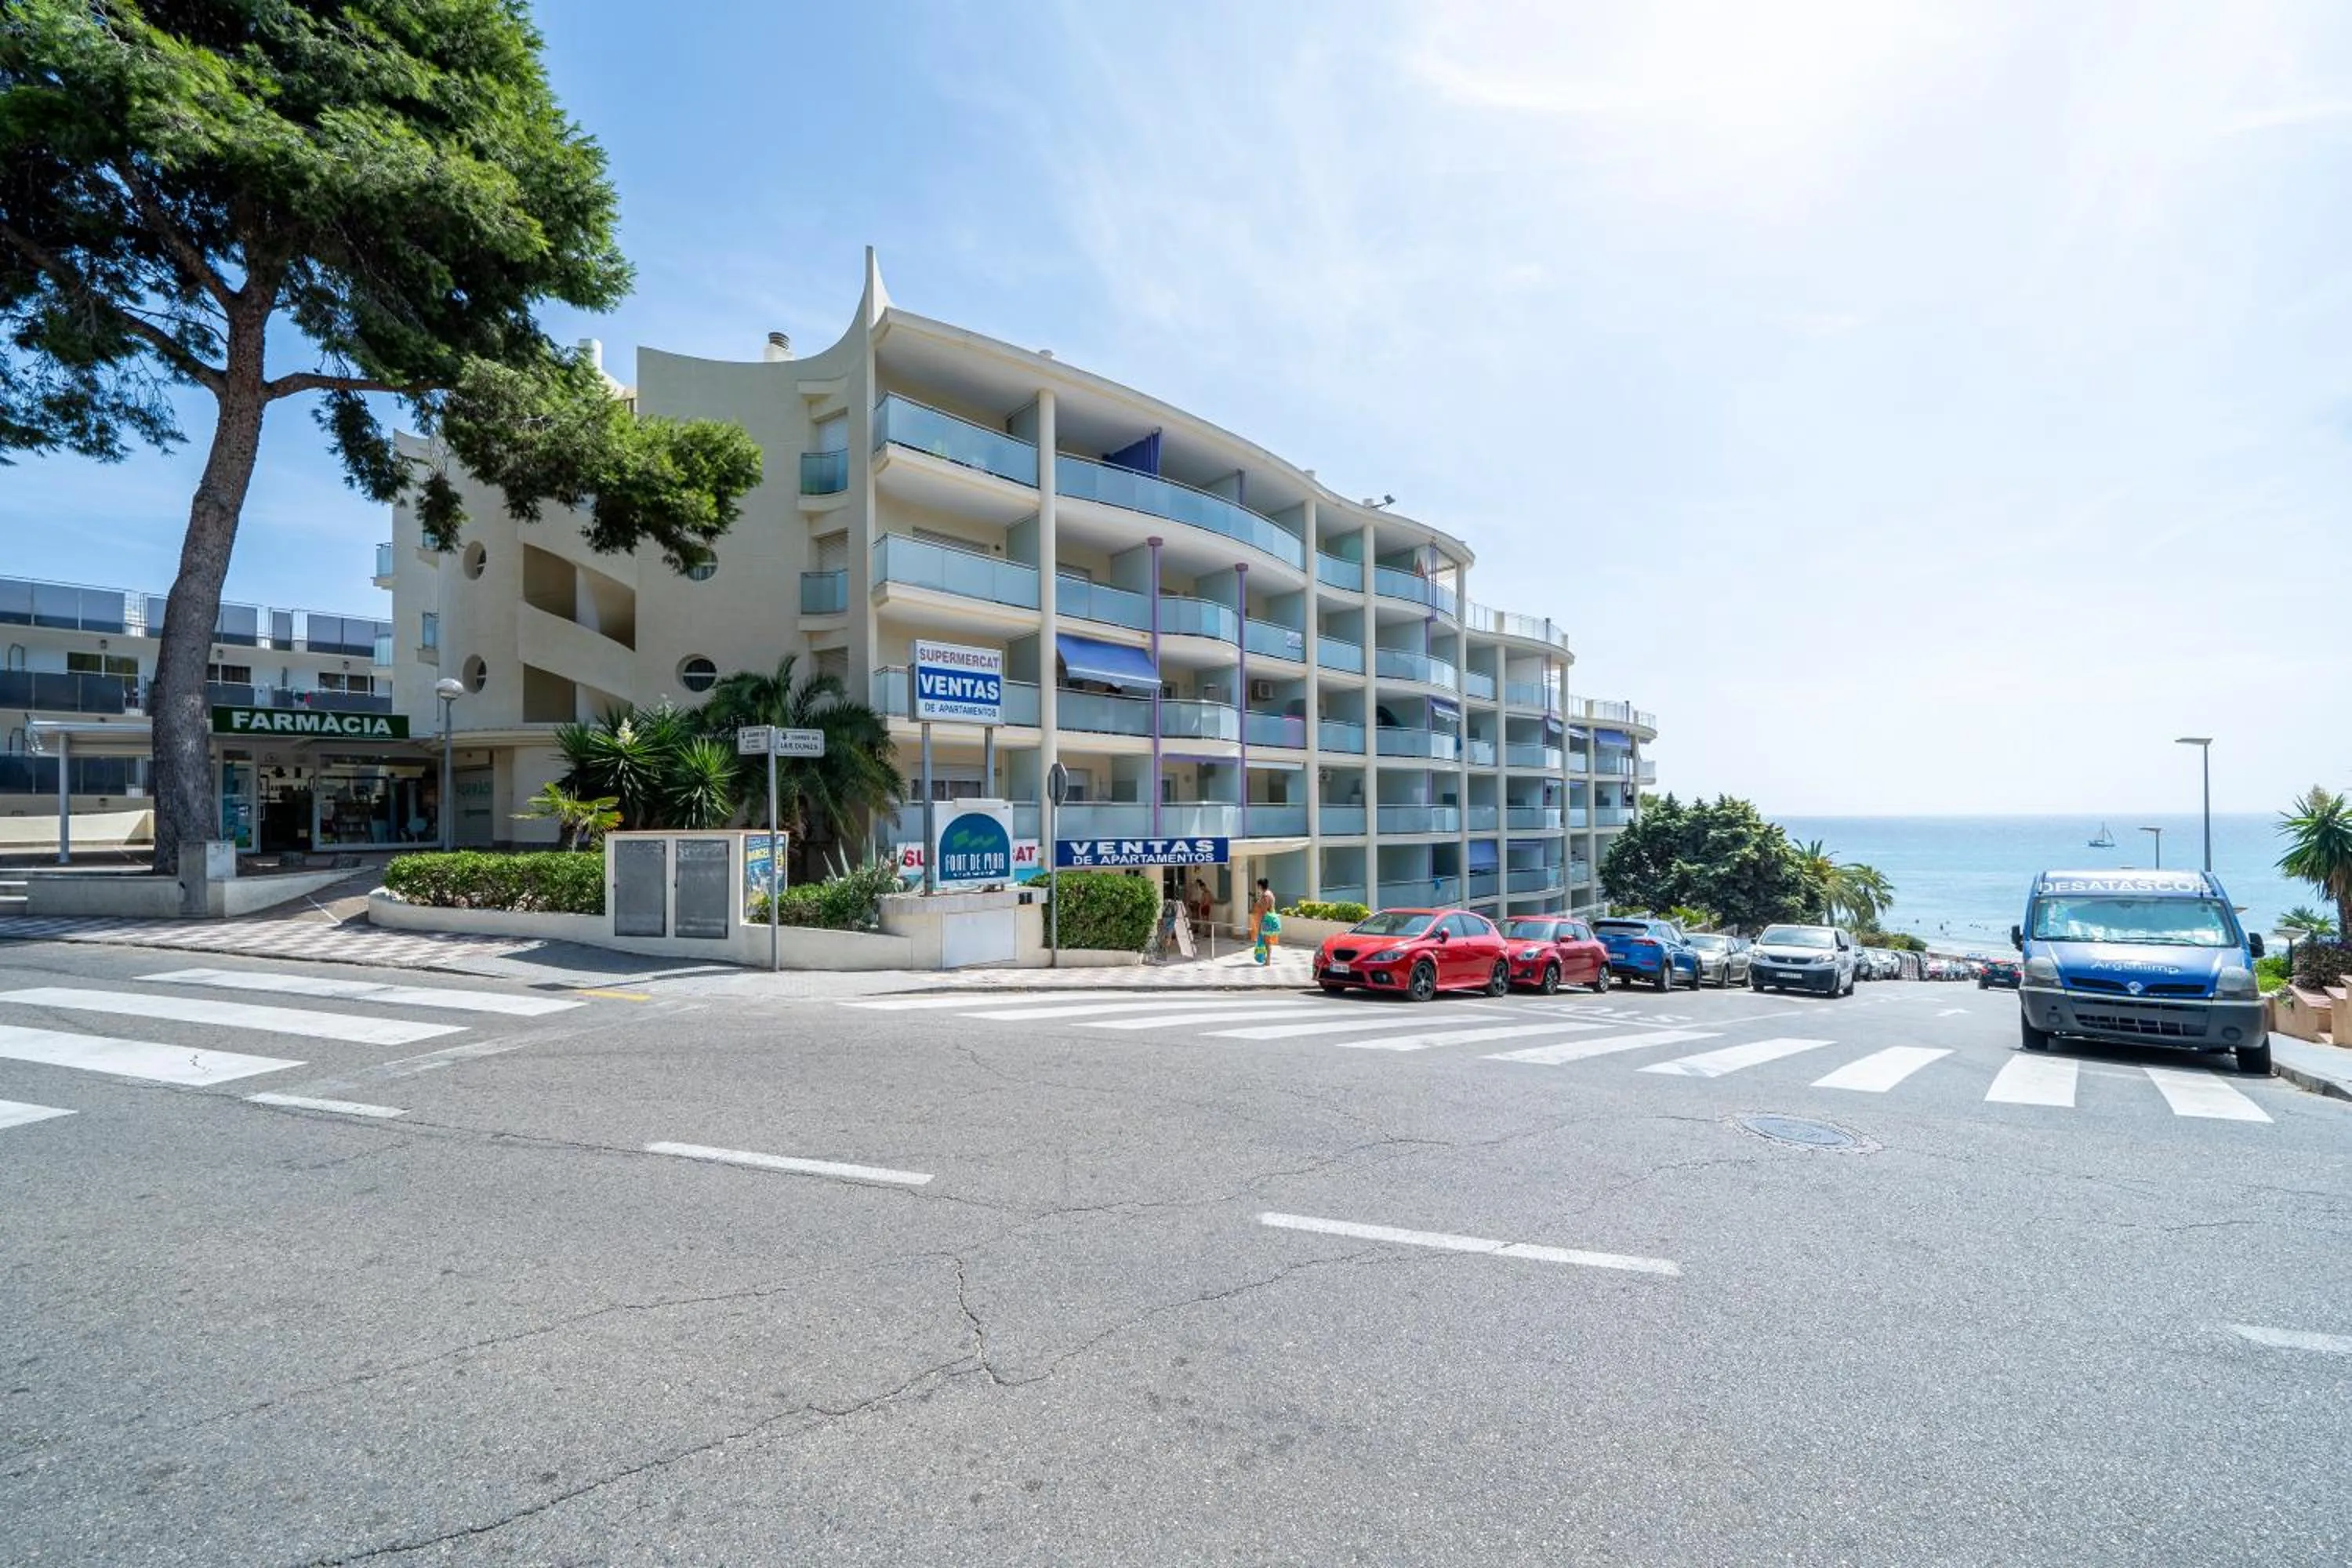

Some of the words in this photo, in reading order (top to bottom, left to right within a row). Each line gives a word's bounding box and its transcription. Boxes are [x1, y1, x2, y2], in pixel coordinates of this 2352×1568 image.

[919, 647, 1000, 669] SUPERMERCAT
[920, 673, 1000, 700] VENTAS
[925, 702, 935, 713] DE
[938, 703, 996, 717] APARTAMENTOS
[231, 711, 393, 735] FARMÀCIA
[1069, 840, 1215, 855] VENTAS
[945, 853, 967, 873] FONT
[971, 853, 981, 871] DE
[1073, 855, 1092, 866] DE
[1100, 852, 1215, 865] APARTAMENTOS
